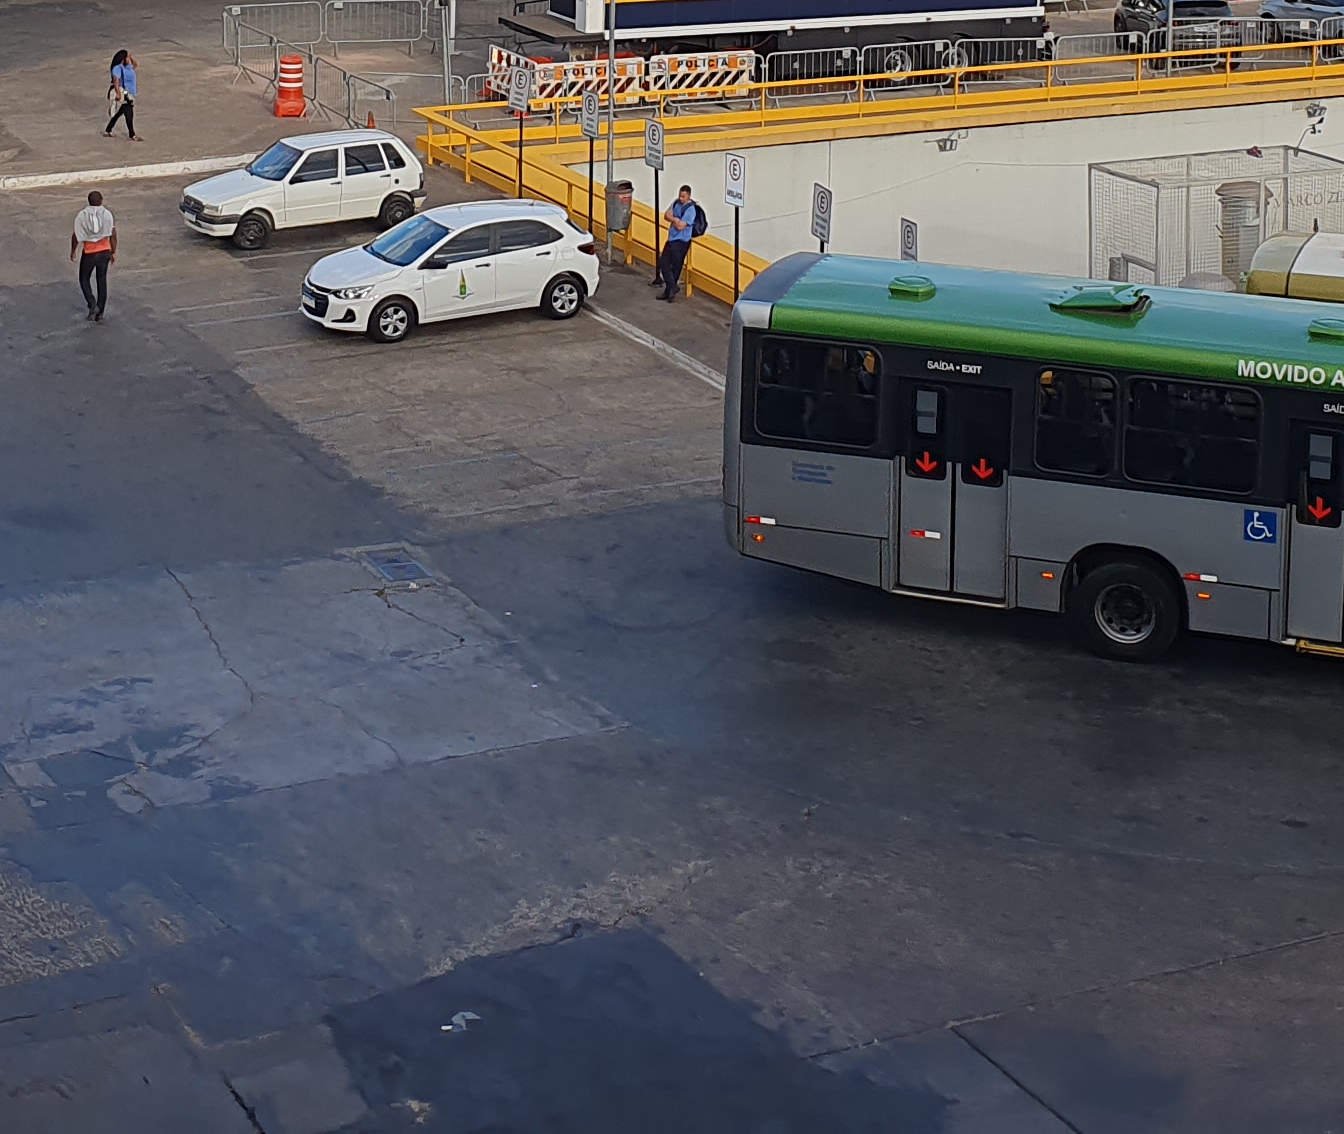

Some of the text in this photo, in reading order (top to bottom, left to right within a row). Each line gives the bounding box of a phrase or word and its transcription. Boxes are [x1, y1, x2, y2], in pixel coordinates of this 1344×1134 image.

[564, 66, 617, 77] POLICI
[517, 75, 525, 86] E
[731, 165, 738, 176] E
[818, 198, 826, 209] E
[927, 360, 982, 374] SAÍDA EXIT
[1237, 359, 1326, 385] MOVIDO
